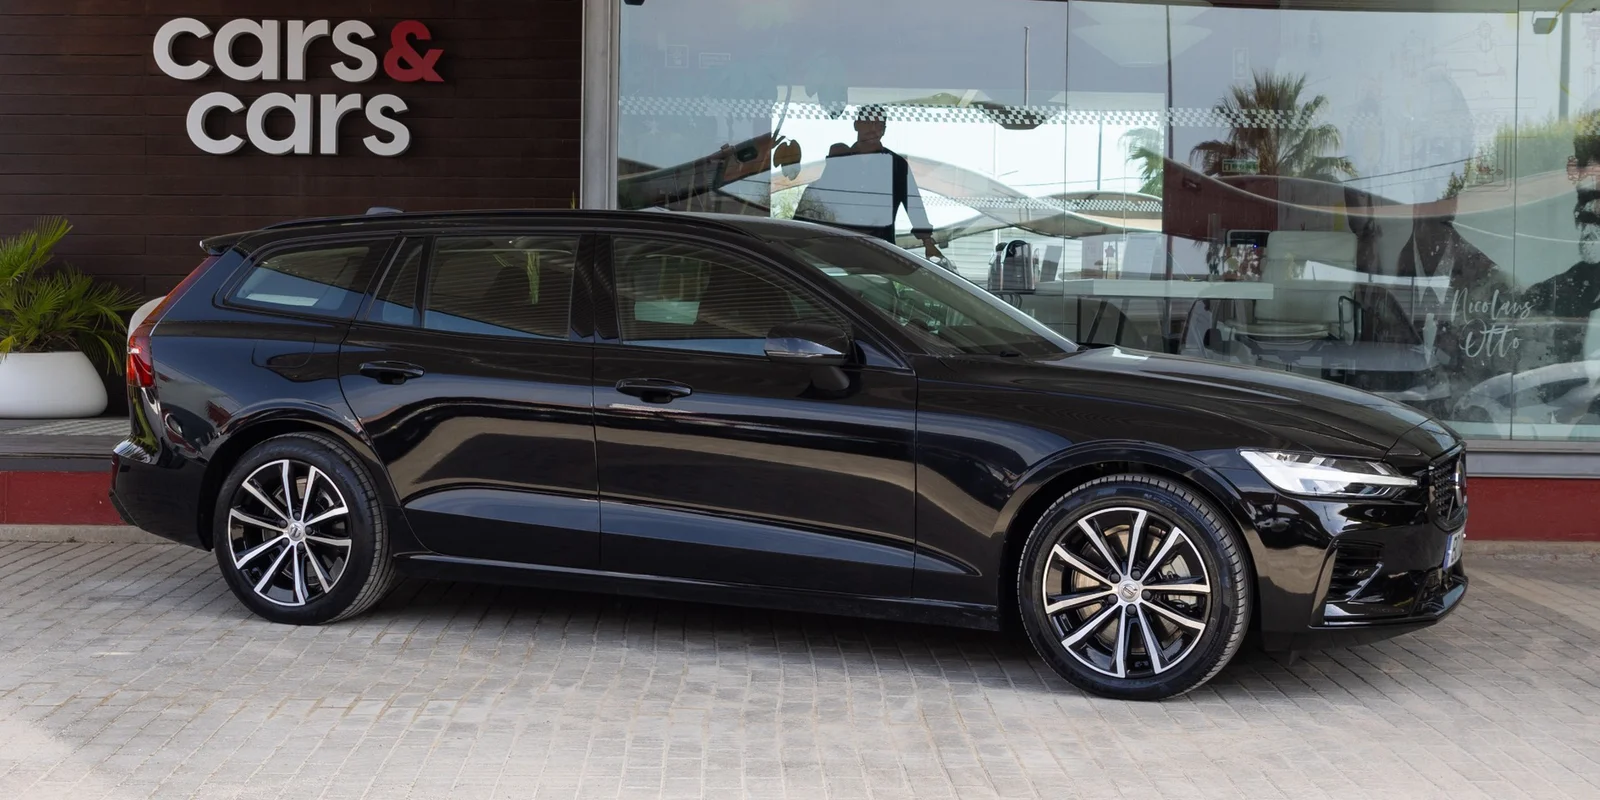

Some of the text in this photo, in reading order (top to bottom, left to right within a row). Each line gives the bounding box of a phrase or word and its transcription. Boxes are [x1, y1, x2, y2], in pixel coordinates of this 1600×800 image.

[186, 91, 412, 156] cars
[1451, 288, 1534, 323] Nicolaus
[1459, 319, 1523, 357] Otto
